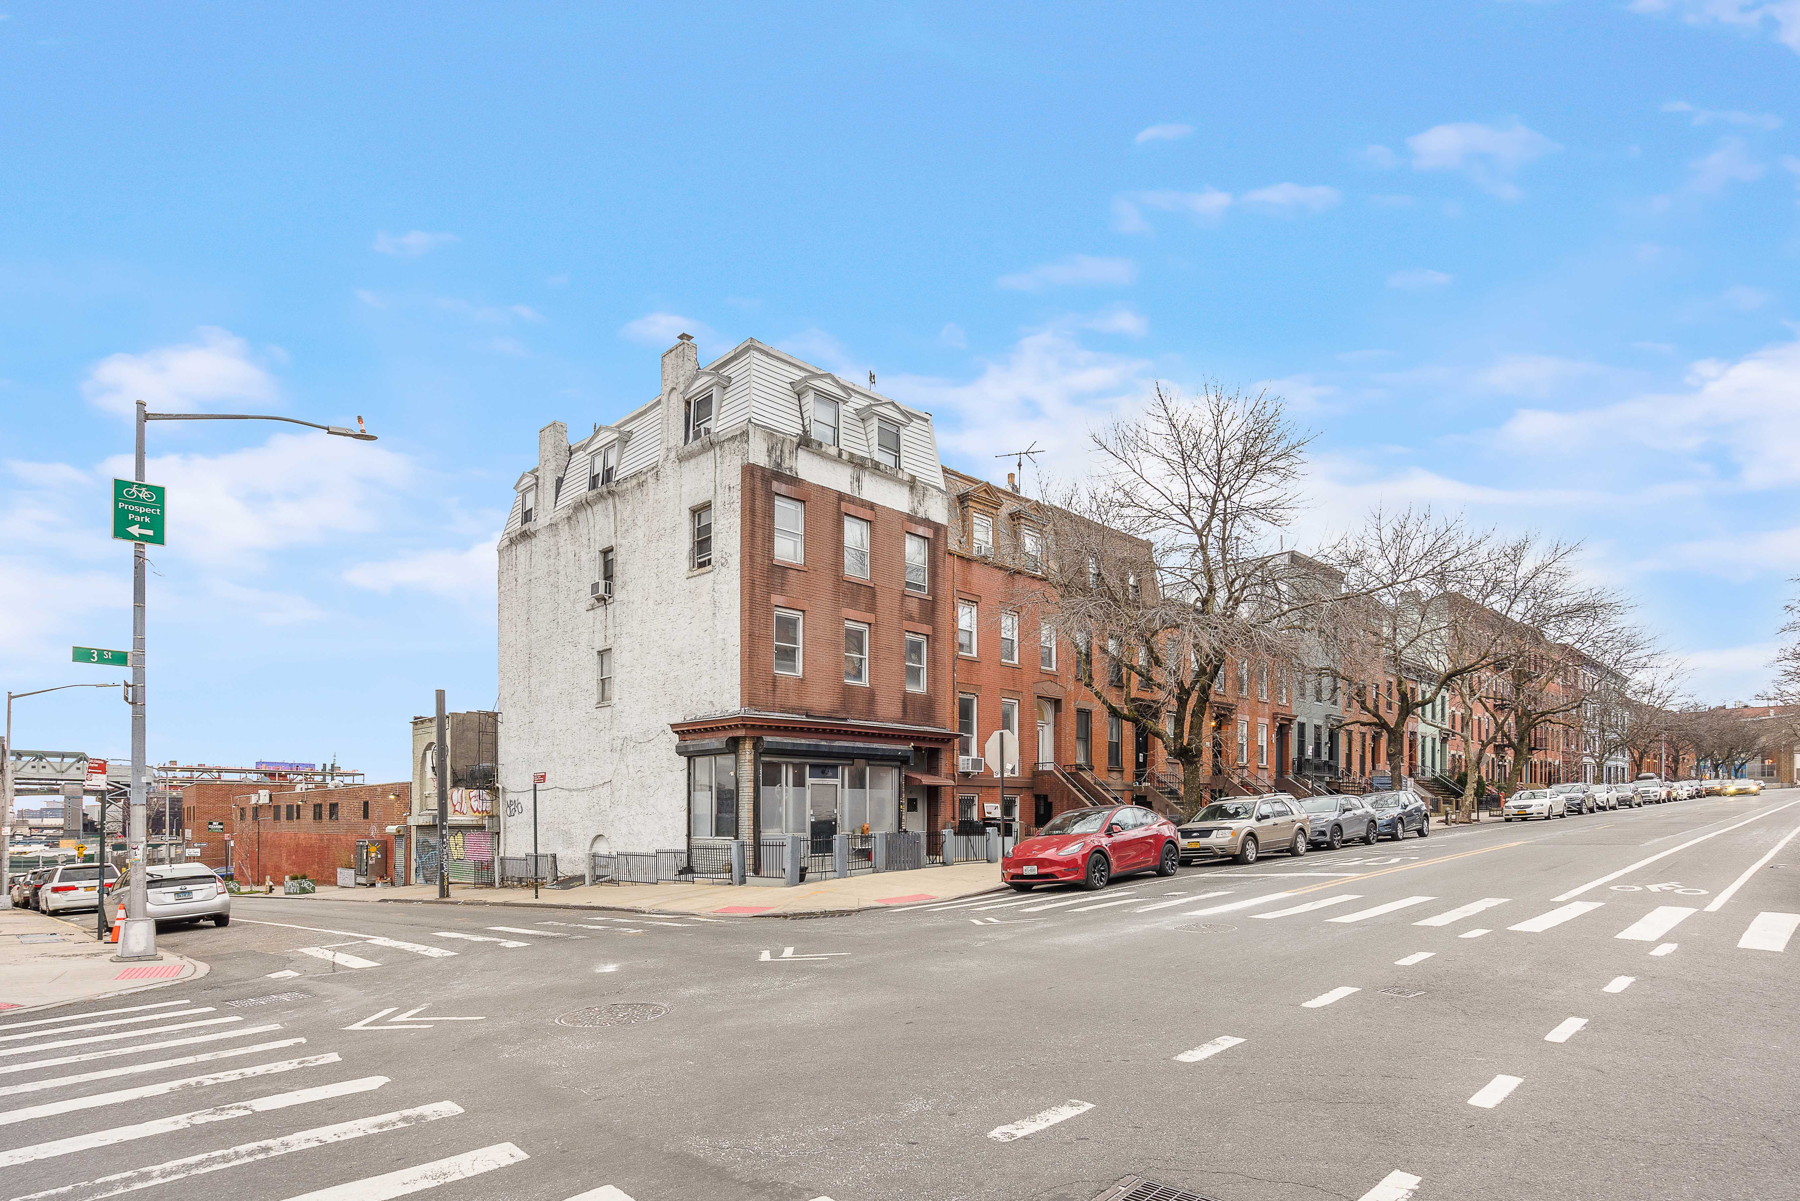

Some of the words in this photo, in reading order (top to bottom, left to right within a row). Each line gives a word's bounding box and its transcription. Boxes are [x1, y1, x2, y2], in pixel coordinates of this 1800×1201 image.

[118, 502, 161, 515] Prospect
[128, 513, 151, 523] Park
[90, 649, 98, 662] 3
[103, 650, 112, 659] St
